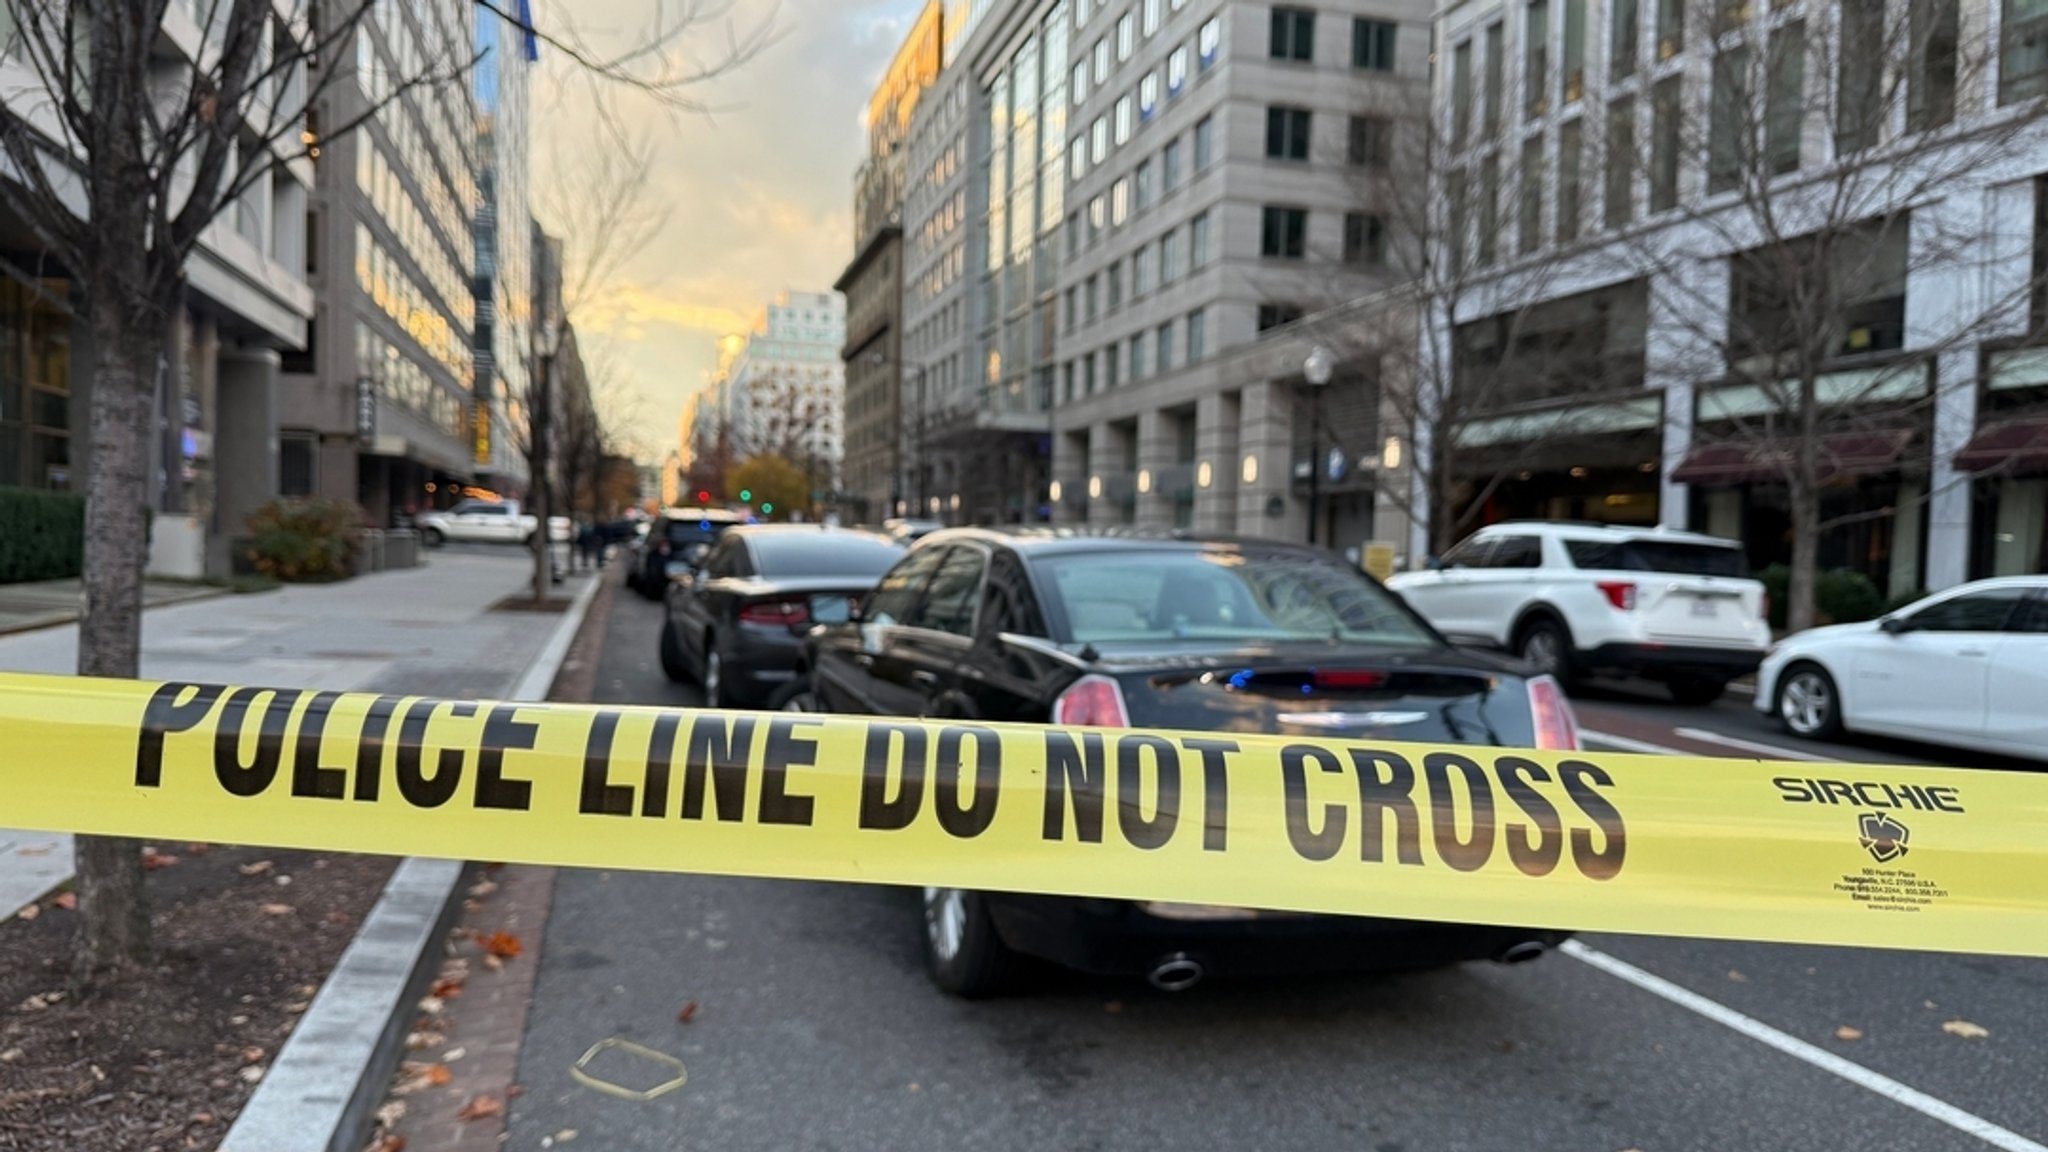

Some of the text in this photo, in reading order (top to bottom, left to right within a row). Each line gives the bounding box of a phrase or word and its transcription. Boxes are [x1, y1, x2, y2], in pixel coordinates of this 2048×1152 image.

[134, 681, 1627, 881] POLICE LINE DO NOT CROSS
[1772, 776, 1965, 813] SIRCHIE
[1898, 870, 1916, 878] Place
